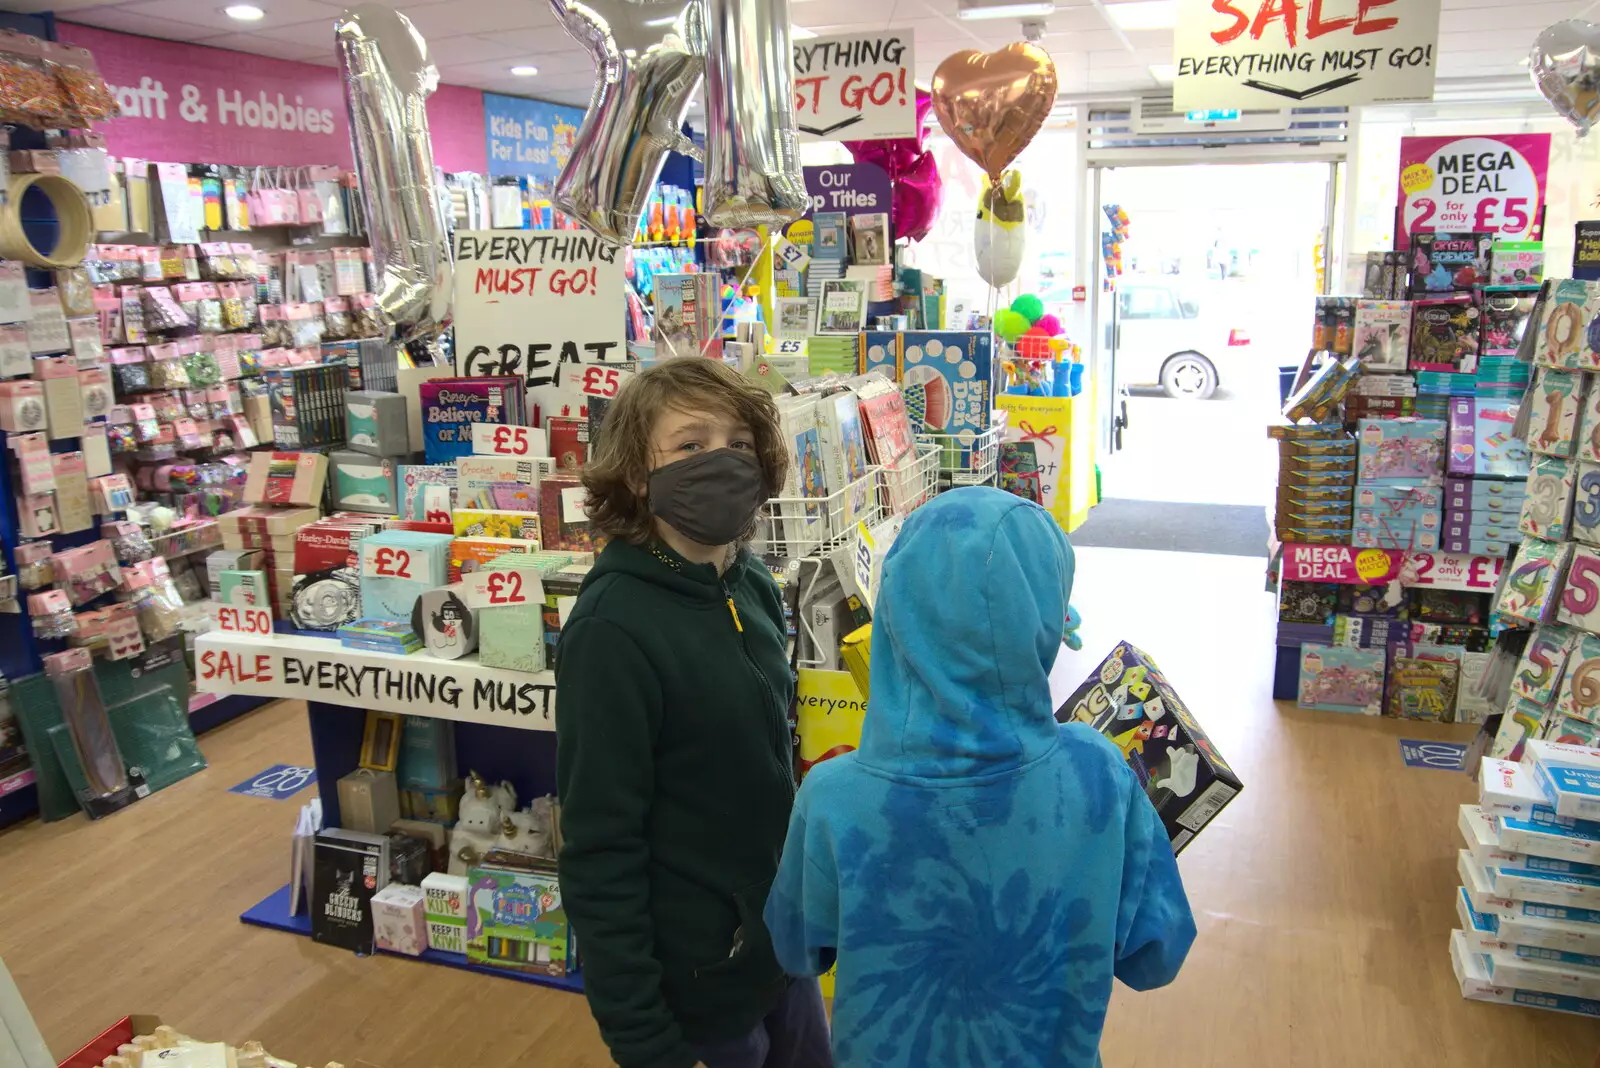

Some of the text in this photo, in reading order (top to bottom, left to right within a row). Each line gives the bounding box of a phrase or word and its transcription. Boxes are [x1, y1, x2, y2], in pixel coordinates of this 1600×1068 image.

[1210, 0, 1400, 48] SALE
[793, 37, 907, 71] RYTHING
[1179, 44, 1433, 77] EVERYTHING MUST GO!
[840, 67, 907, 108] GO!
[179, 84, 208, 123] &
[218, 88, 335, 135] Hobbies
[490, 115, 548, 141] Kids Fun
[491, 139, 512, 160] For
[1437, 151, 1515, 175] MEGA
[819, 170, 851, 187] Our
[1442, 173, 1508, 196] DEAL
[807, 189, 877, 212] op Titles
[1445, 201, 1464, 211] for
[1410, 197, 1437, 233] 2
[1440, 212, 1468, 223] only
[1471, 197, 1529, 234] £5
[789, 230, 814, 238] Amazin
[457, 235, 619, 265] EVERYTHING
[783, 246, 802, 263] £7
[475, 266, 597, 296] MUST GO!
[780, 341, 801, 353] £5
[463, 340, 618, 389] GREAT
[582, 365, 620, 398] £5
[427, 406, 482, 424] Believe
[953, 381, 968, 427] Den
[965, 380, 982, 428] Play
[438, 429, 455, 442] or
[492, 425, 529, 455] £5
[374, 547, 412, 578] £2
[856, 537, 871, 591] £15
[1295, 547, 1352, 564] MEGA
[1413, 553, 1435, 584] 2
[1443, 556, 1460, 566] for
[1298, 563, 1347, 579] DEAL
[1438, 566, 1463, 577] only
[487, 571, 526, 604] £2
[218, 607, 271, 635] £1.50
[200, 649, 556, 719] SALE EVERYTHING MUST
[798, 694, 868, 715] veryone
[425, 888, 447, 898] KEEP
[324, 902, 363, 922] BLINDERS
[431, 923, 461, 937] KEEP IT
